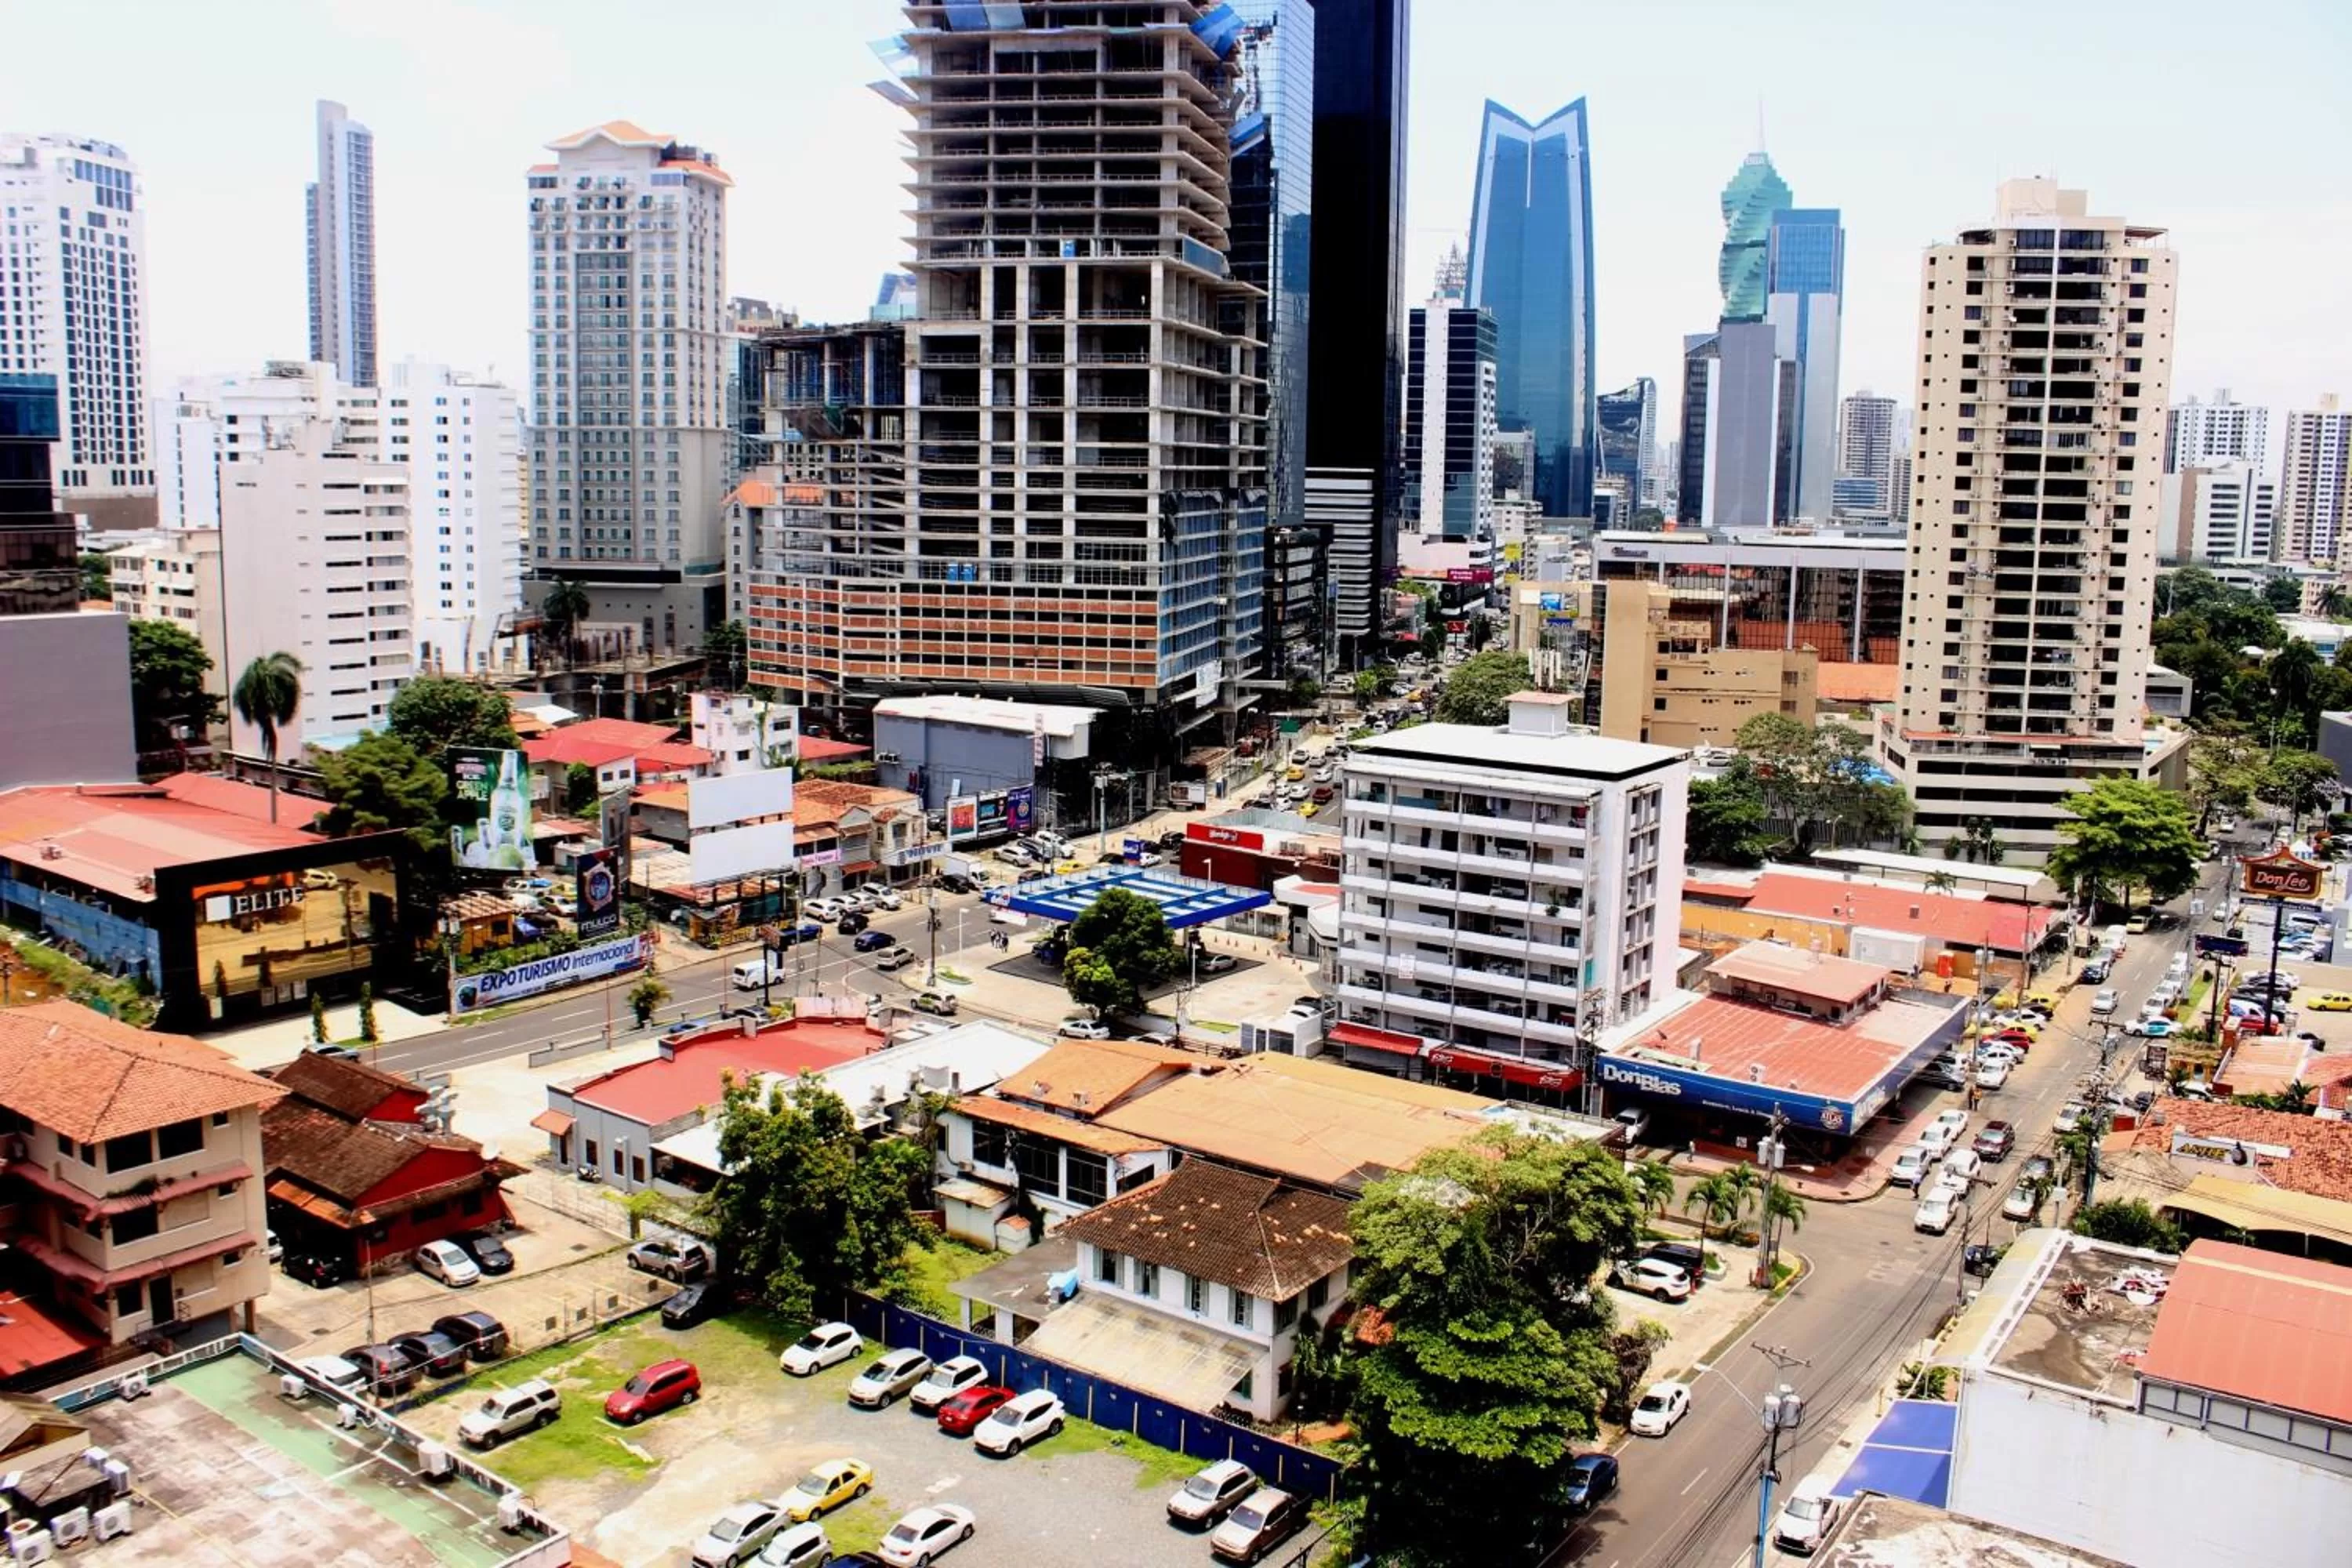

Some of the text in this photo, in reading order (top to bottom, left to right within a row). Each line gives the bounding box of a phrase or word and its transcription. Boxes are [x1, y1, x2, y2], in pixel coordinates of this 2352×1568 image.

[457, 789, 488, 801] APPLE
[2255, 871, 2311, 892] Don Lee
[235, 887, 305, 915] ELITE
[481, 971, 517, 993] EXPO
[517, 956, 572, 985] TURISMO
[572, 940, 637, 969] Internacional
